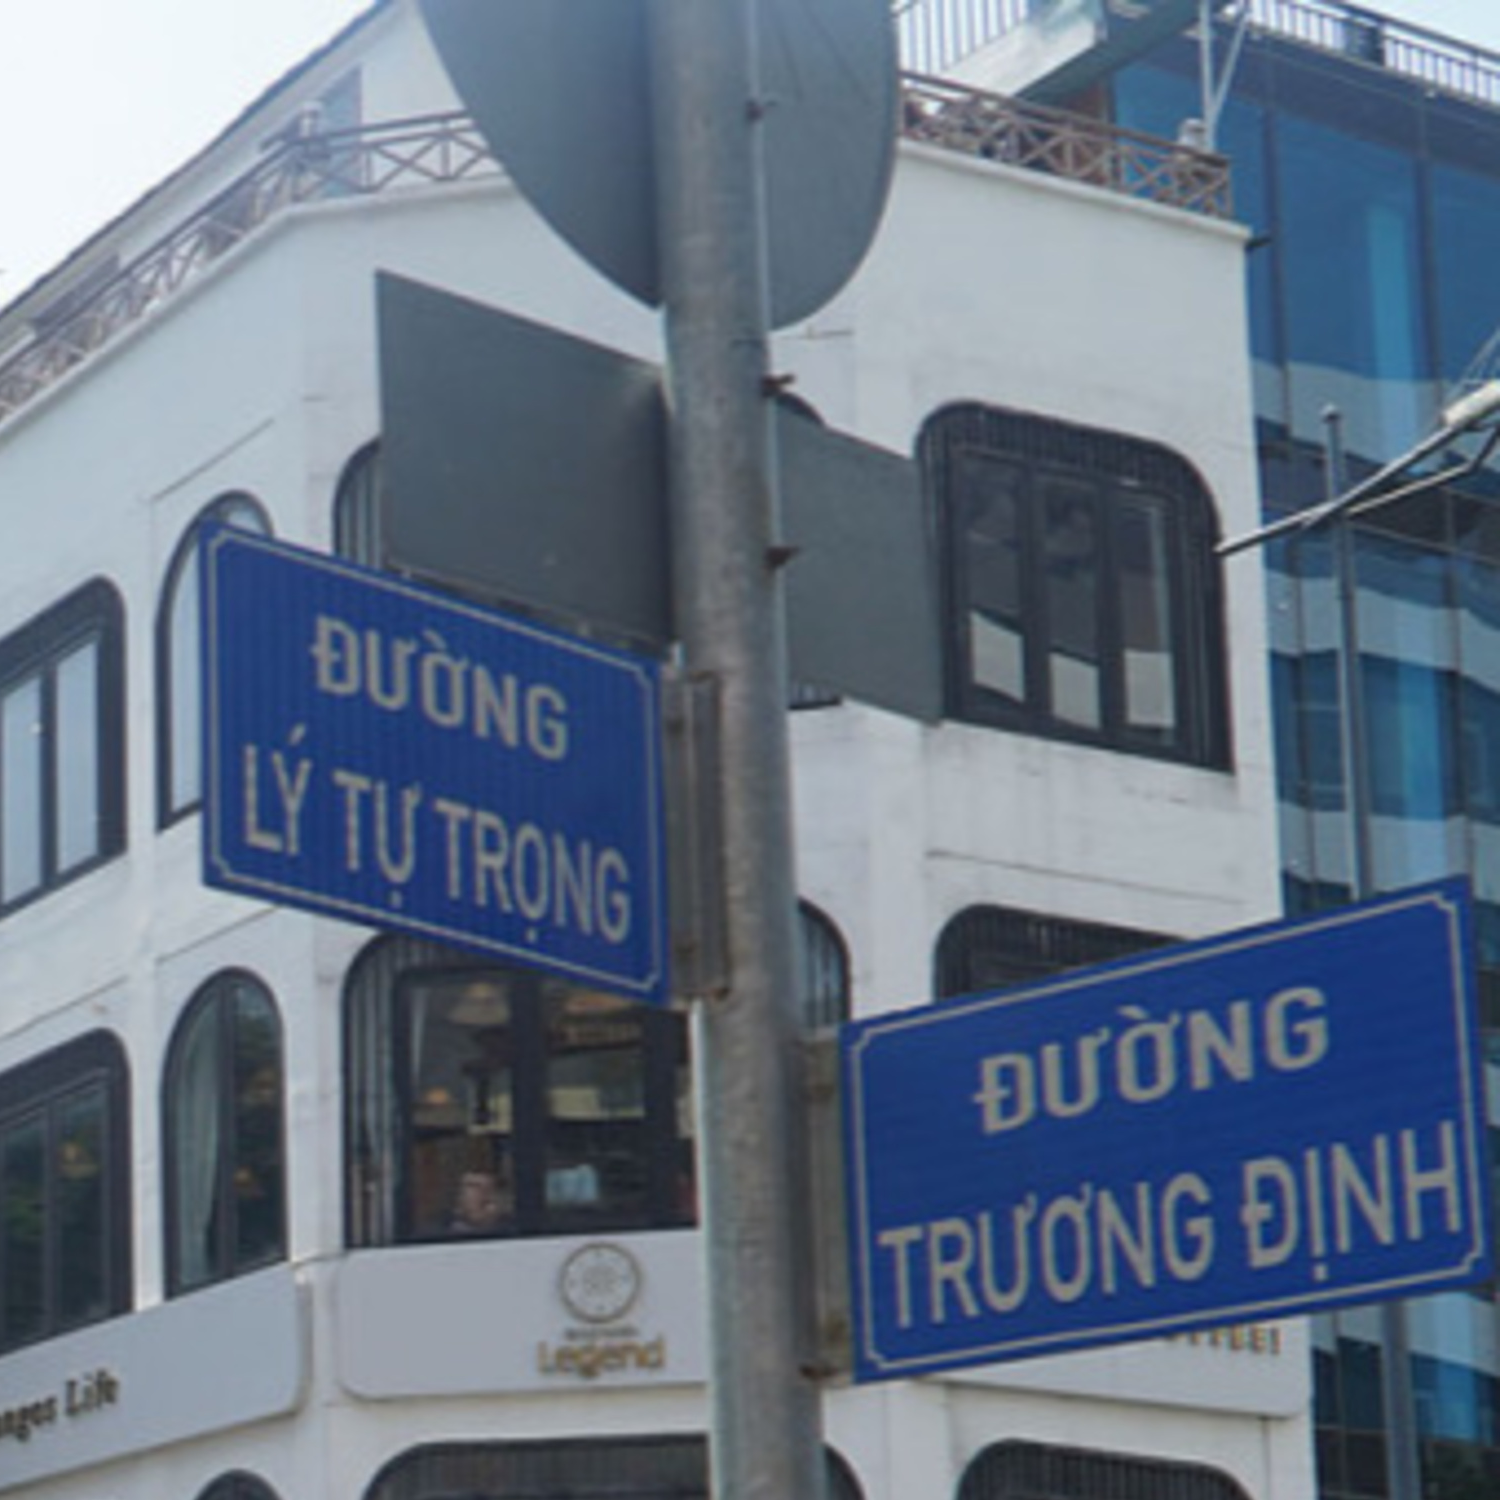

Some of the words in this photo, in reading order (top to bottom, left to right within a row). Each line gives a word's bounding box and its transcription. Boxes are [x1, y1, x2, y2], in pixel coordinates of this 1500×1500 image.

[310, 614, 568, 761] ĐƯỜNG
[243, 723, 312, 857] LÝ
[332, 769, 422, 907] TỰ
[435, 798, 632, 944] TRỌNG
[973, 986, 1329, 1135] ĐƯỜNG
[877, 1172, 1215, 1329] TRƯƠNG
[1240, 1119, 1463, 1282] ĐỊNH
[64, 1367, 120, 1417] Life
[536, 1333, 666, 1380] Legend
